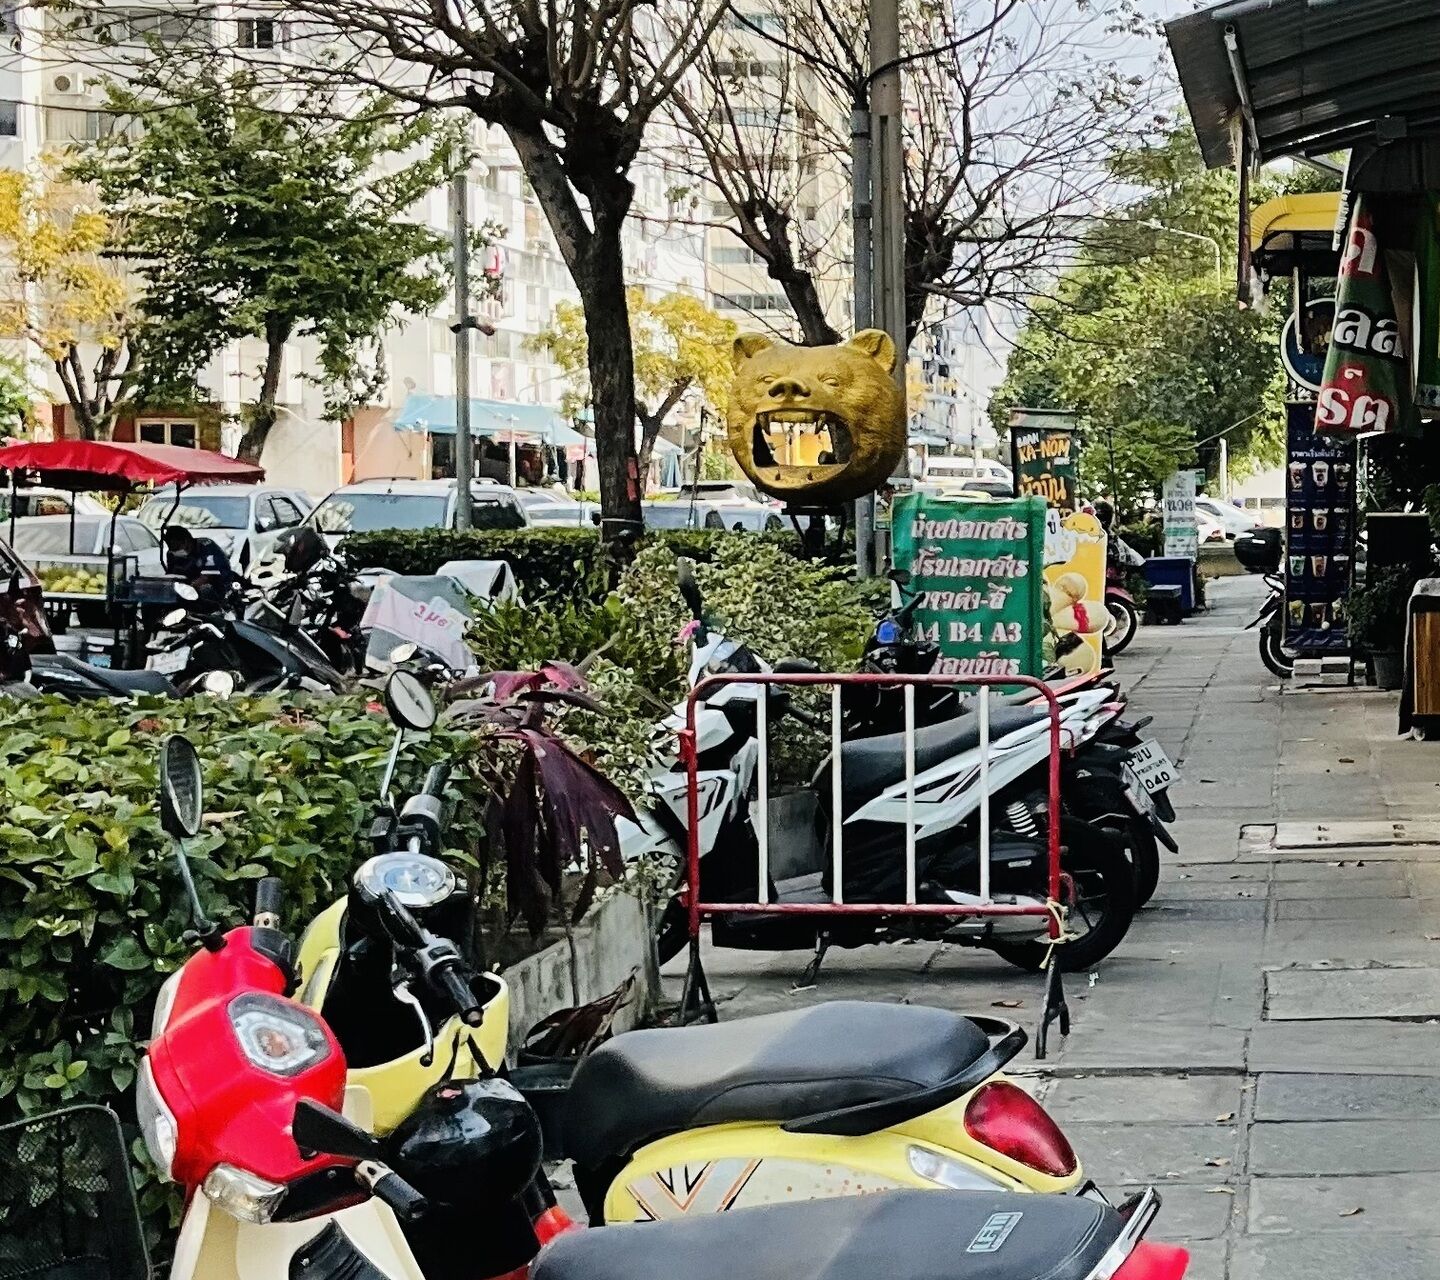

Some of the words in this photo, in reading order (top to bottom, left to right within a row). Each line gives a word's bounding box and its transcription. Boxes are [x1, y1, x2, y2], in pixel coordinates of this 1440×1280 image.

[1018, 438, 1071, 465] KA-NOM
[914, 621, 941, 642] A4
[949, 622, 983, 642] B4
[990, 622, 1022, 642] A3
